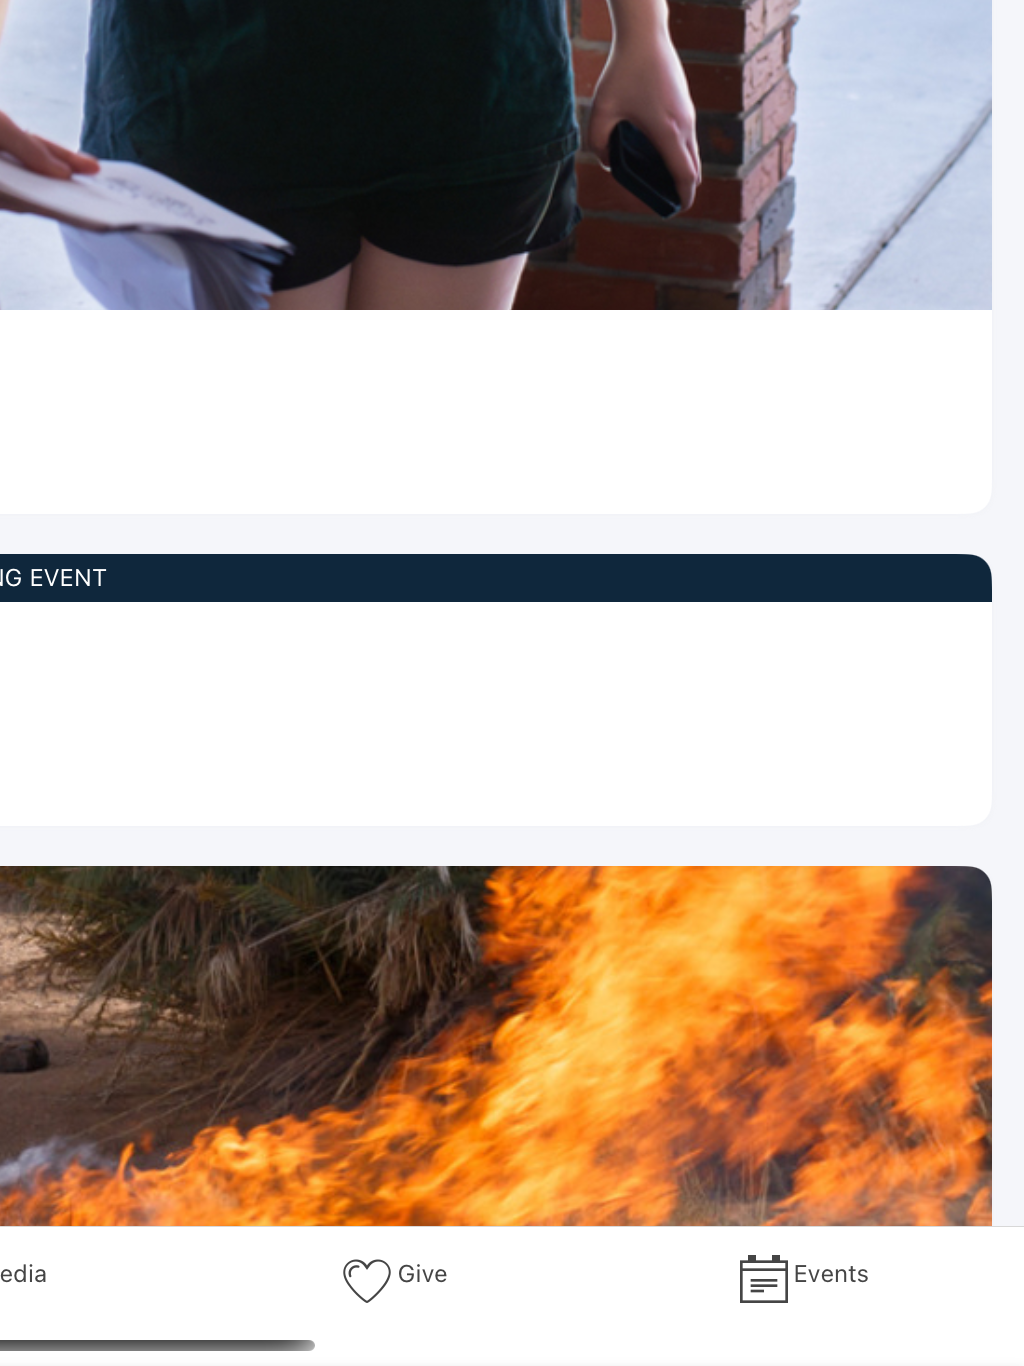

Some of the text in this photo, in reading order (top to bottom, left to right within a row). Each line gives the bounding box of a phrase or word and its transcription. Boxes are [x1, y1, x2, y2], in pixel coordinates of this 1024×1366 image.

[30, 568, 107, 587] EVENT
[398, 1263, 448, 1284] Give
[794, 1264, 869, 1283] Events
